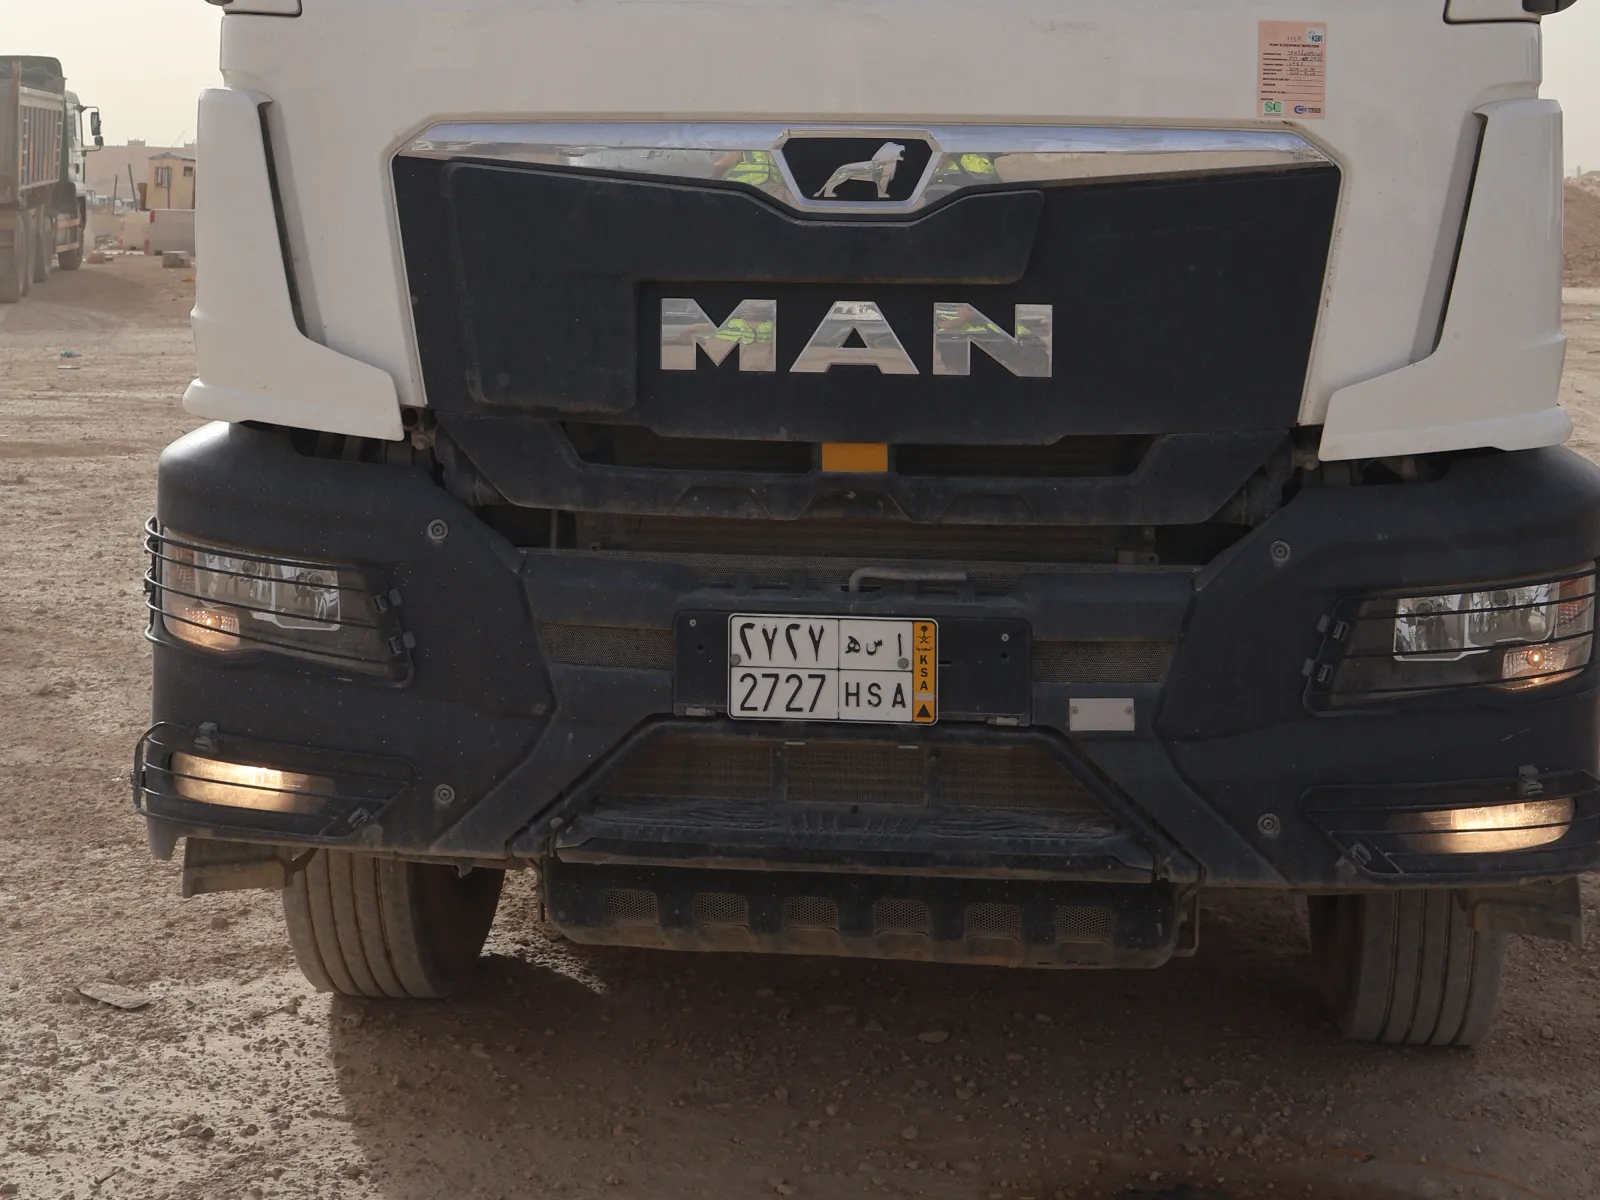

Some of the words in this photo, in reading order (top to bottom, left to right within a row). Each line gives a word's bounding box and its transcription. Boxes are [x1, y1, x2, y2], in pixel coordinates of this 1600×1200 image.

[1264, 101, 1282, 113] SC
[660, 298, 1053, 377] MAN
[739, 673, 826, 713] 2727
[844, 681, 907, 709] HSA
